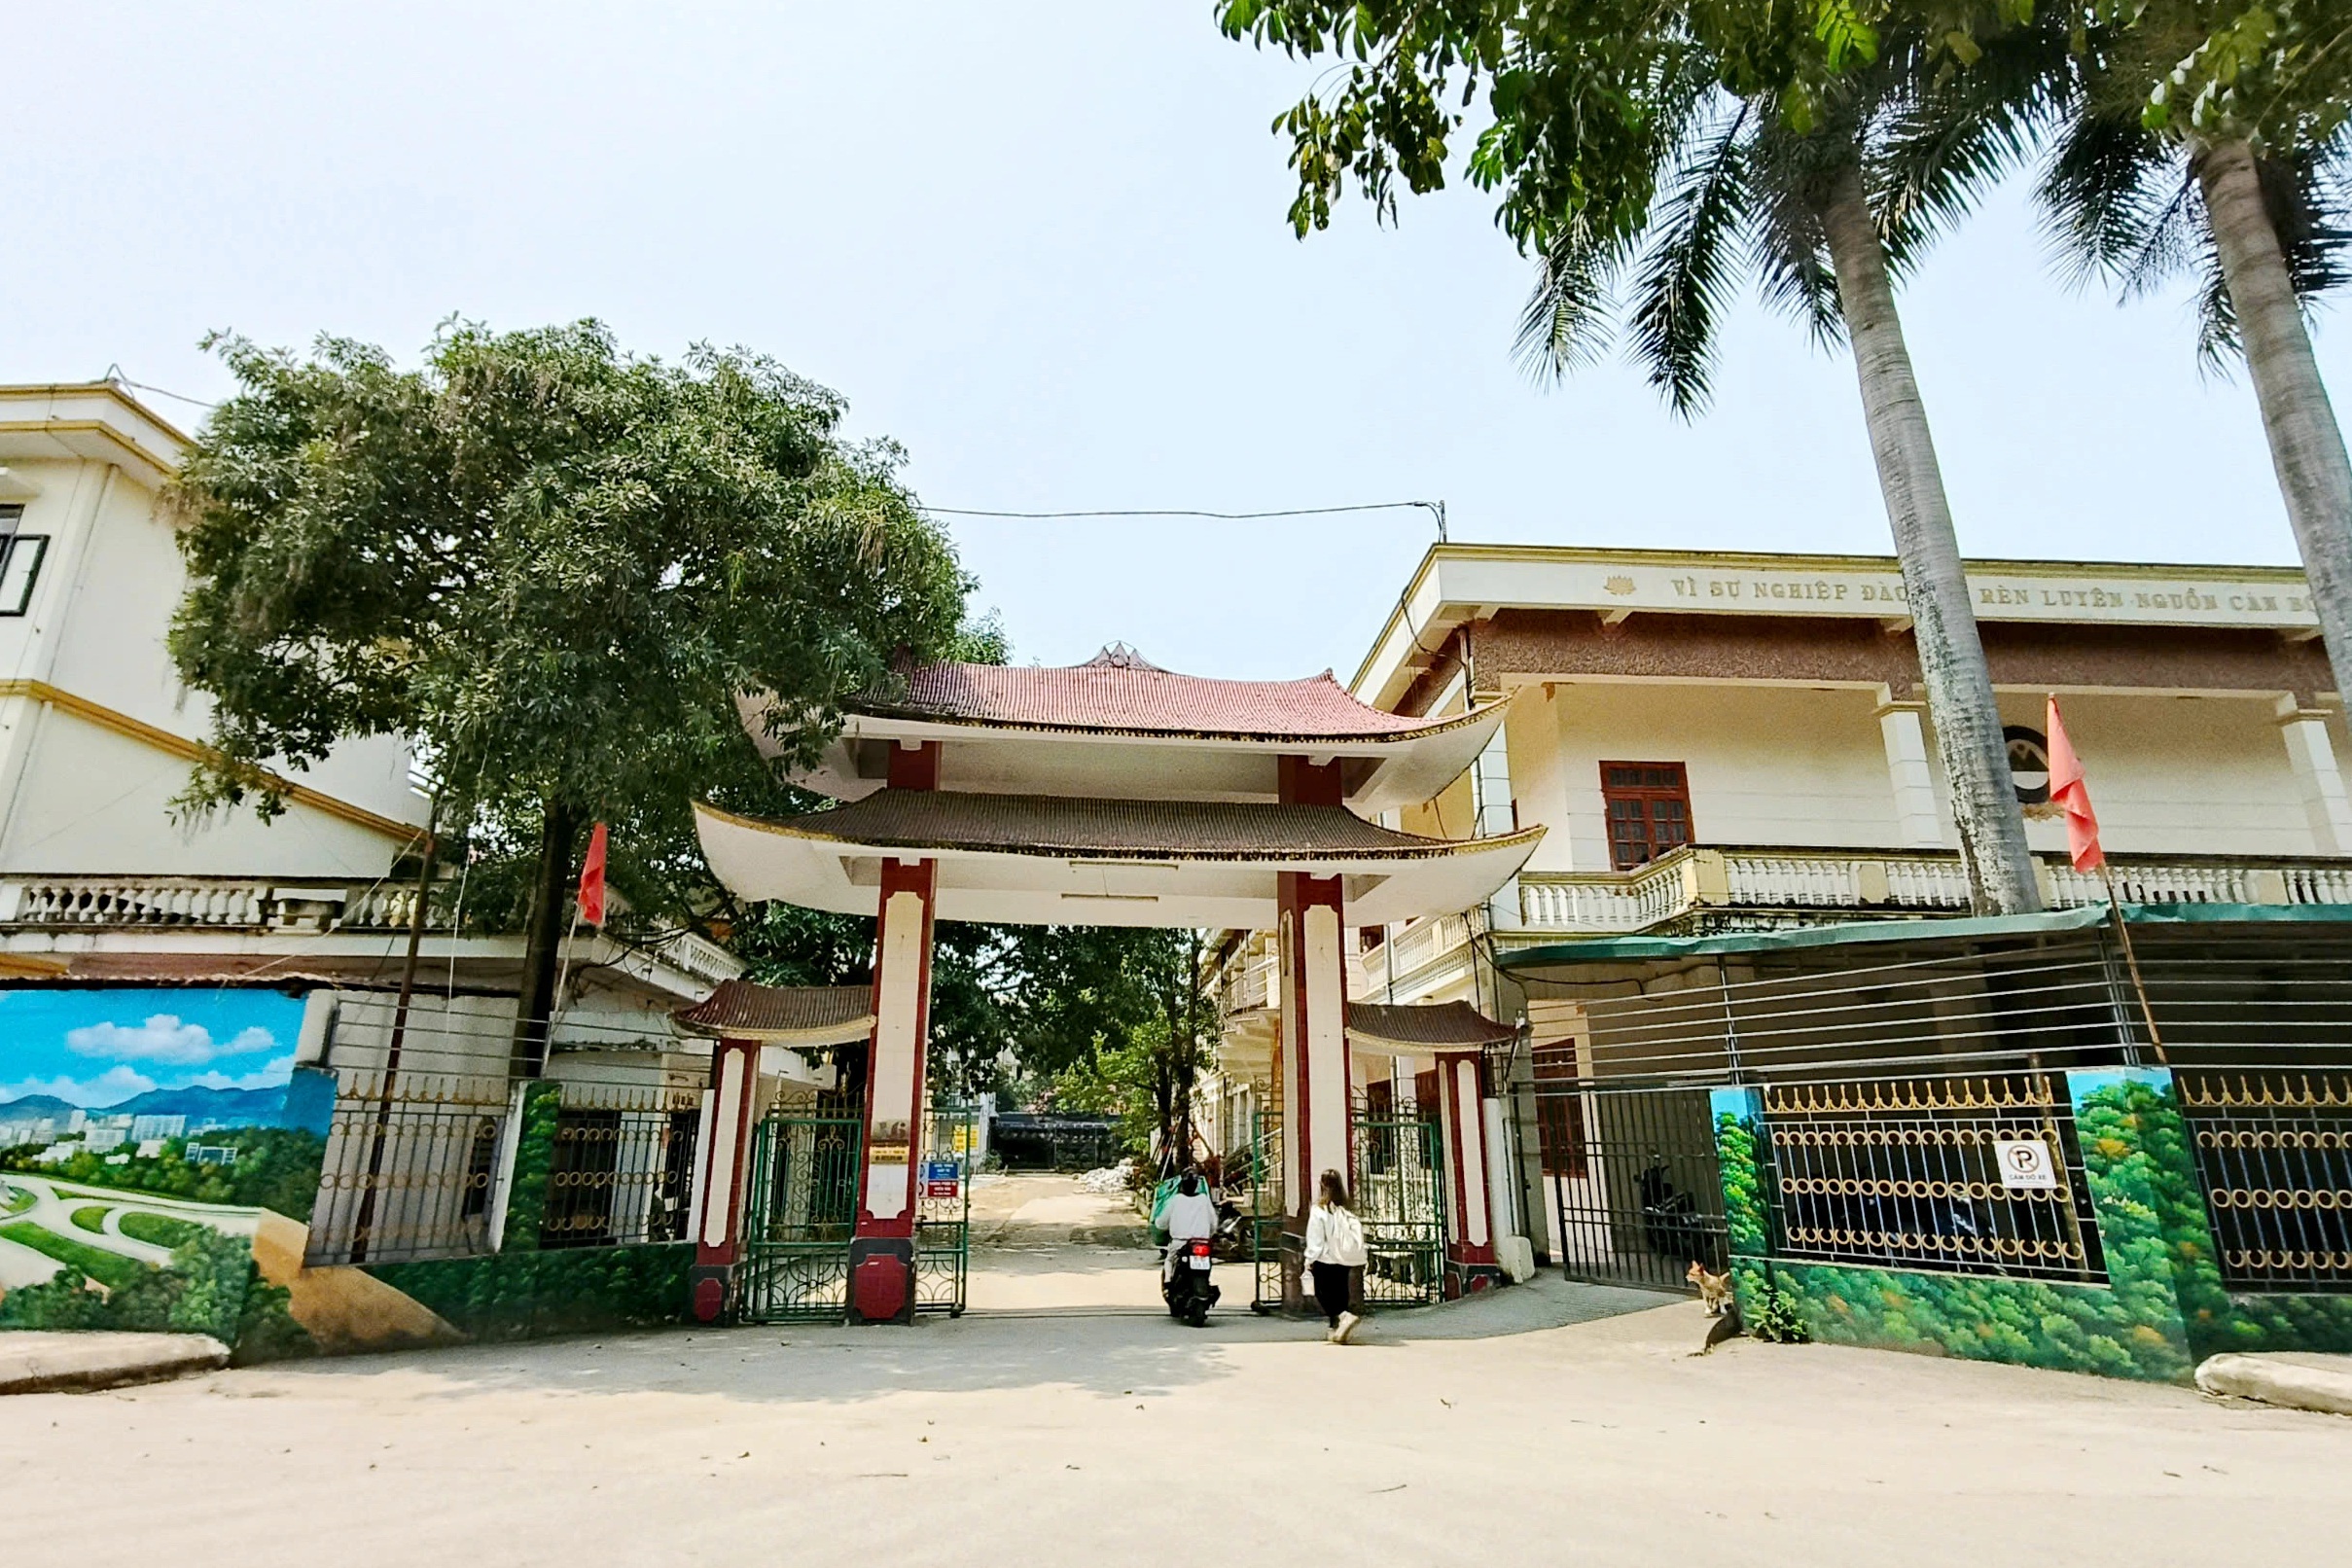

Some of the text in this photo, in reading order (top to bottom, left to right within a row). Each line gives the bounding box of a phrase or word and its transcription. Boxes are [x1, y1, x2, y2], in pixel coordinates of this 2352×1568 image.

[1670, 576, 1697, 597] VÌ
[1710, 579, 1741, 601] SỰ
[1753, 580, 1847, 602] NGHIỆP
[1978, 585, 2030, 605] RÈN
[2016, 1150, 2032, 1168] P
